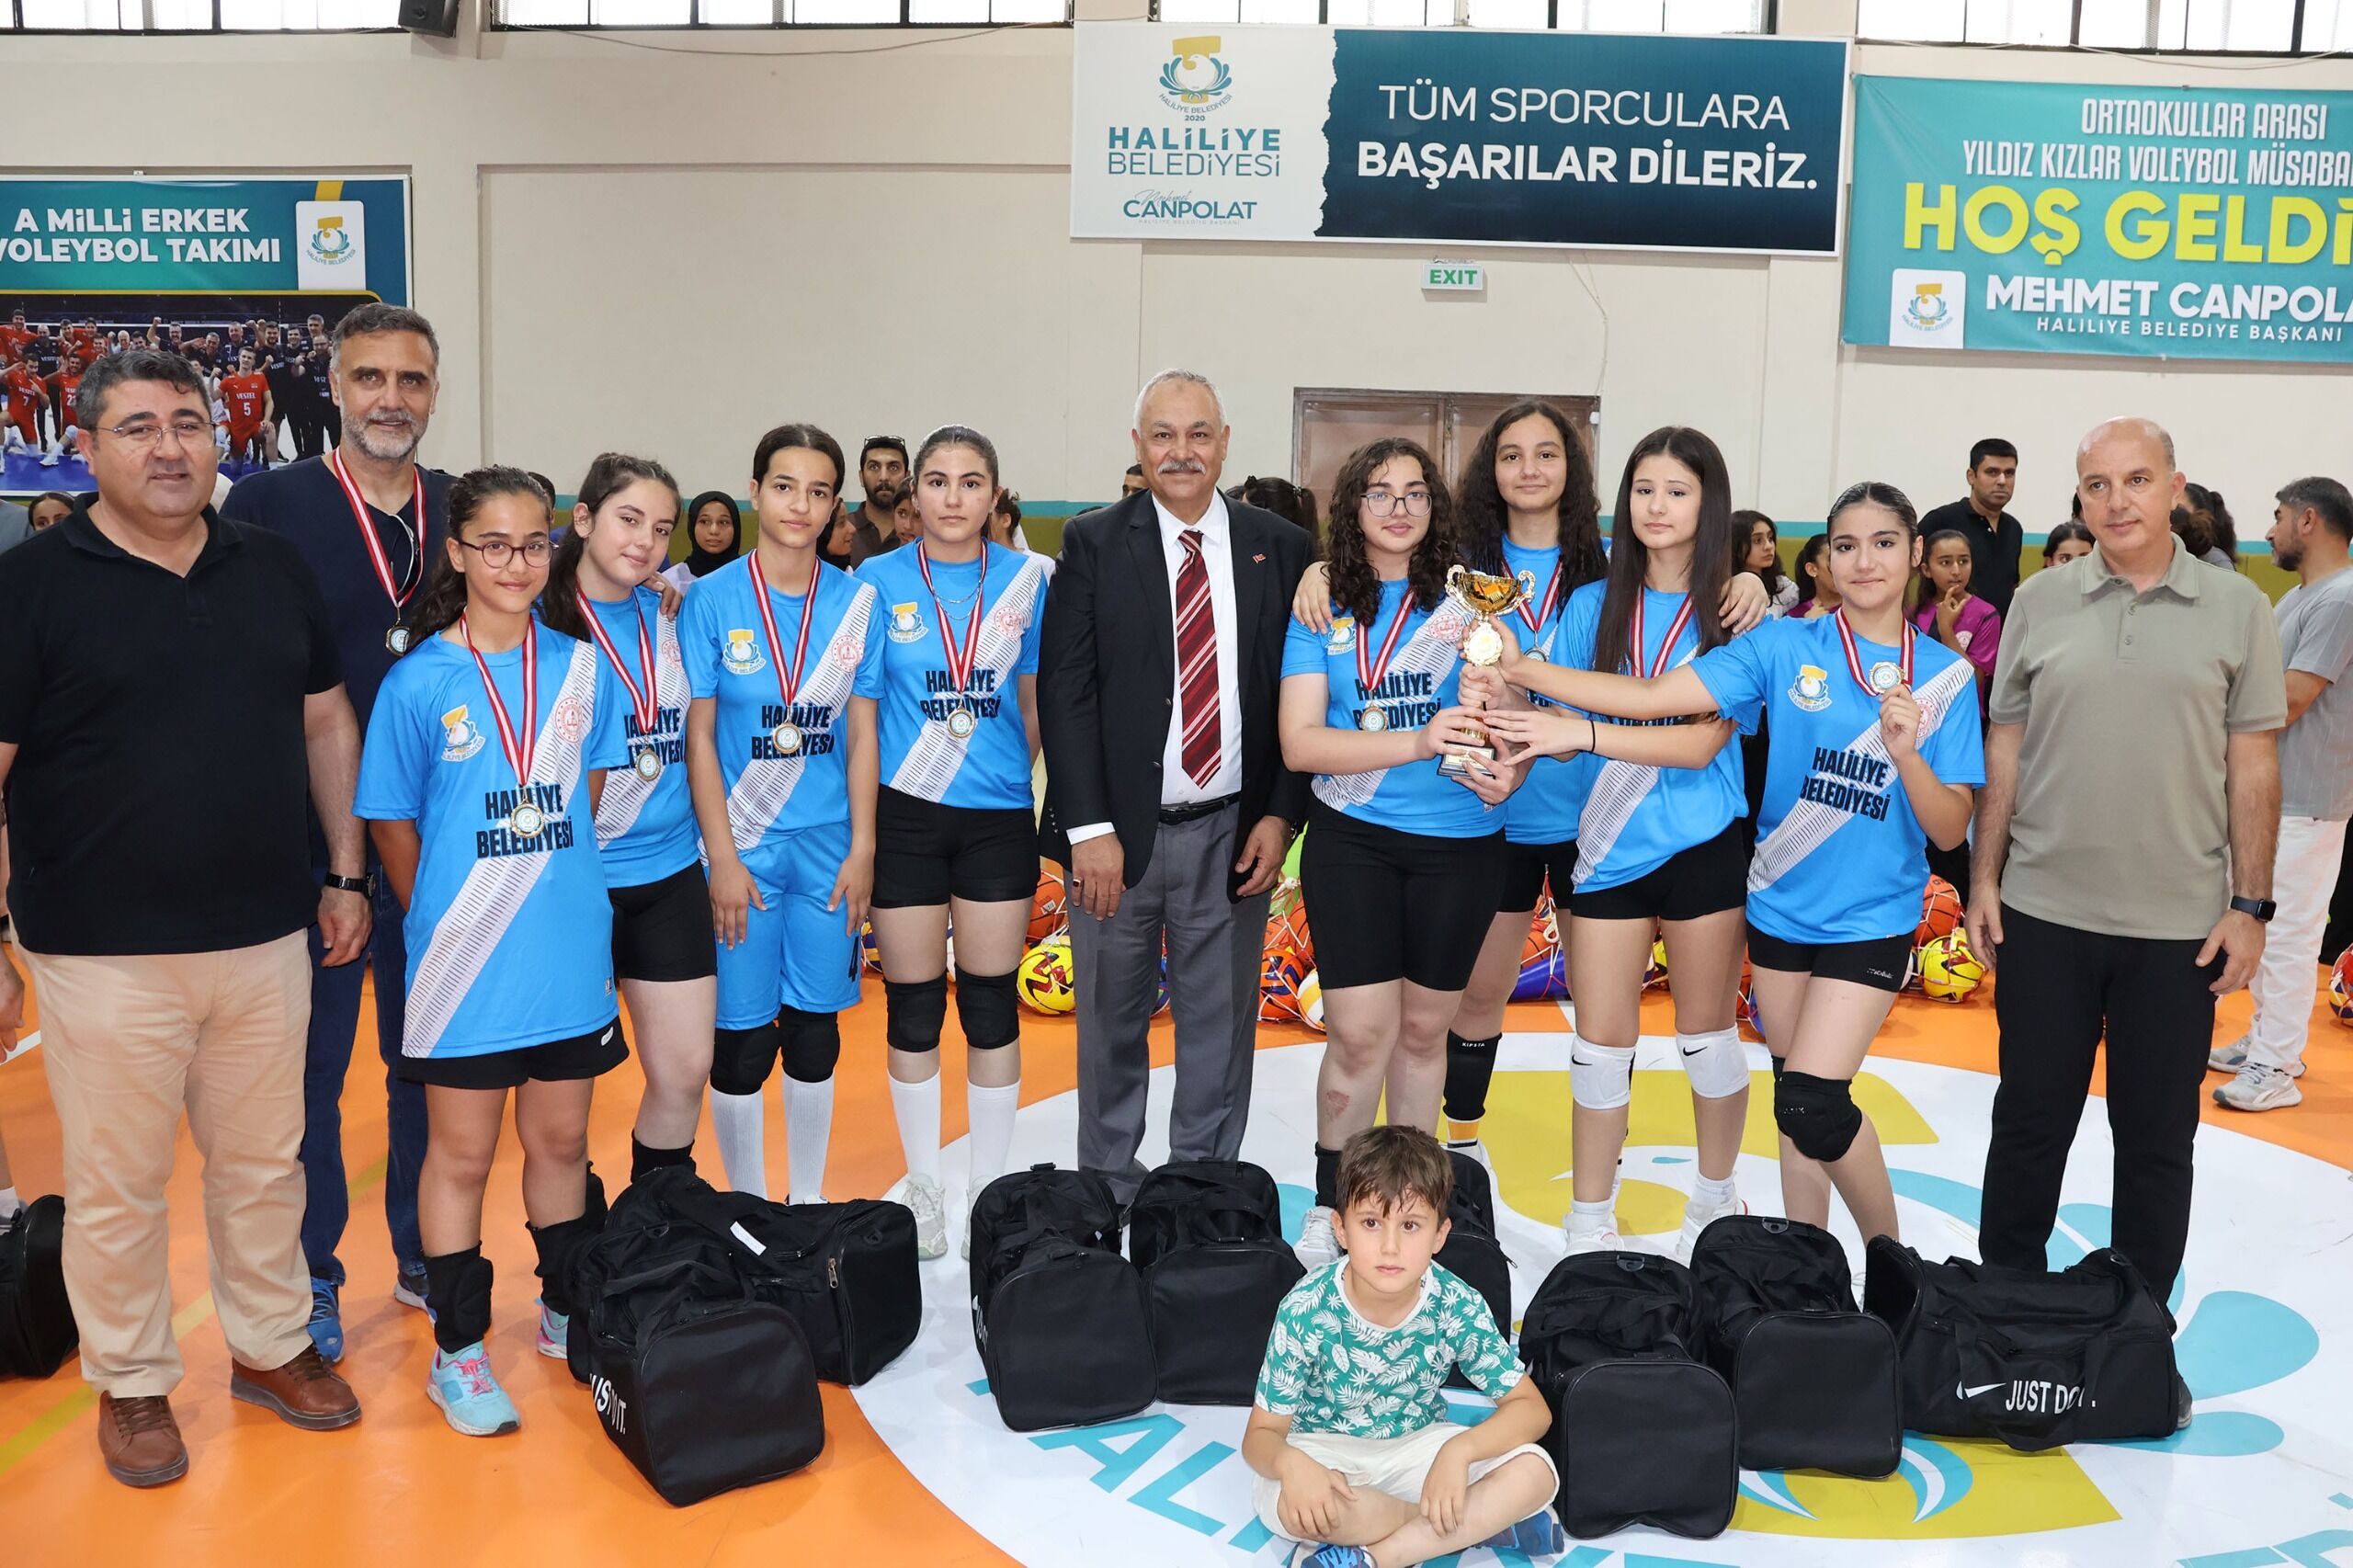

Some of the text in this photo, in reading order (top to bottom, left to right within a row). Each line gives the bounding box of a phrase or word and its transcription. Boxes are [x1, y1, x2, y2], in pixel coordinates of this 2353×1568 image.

[1379, 78, 1790, 131] TÜM SPORCULARA
[2081, 98, 2328, 141] ORTAOKULLAR ARASI
[1358, 138, 1818, 190] BAŞARILAR DİLERİZ.
[1962, 140, 2353, 187] YILDIZ KIZLAR VOLEYBOL MÜSABA
[14, 208, 40, 233] A
[142, 208, 250, 233] ERKEK
[1122, 199, 1258, 220] CANPOLAT
[1904, 182, 2082, 266] HOŞ
[166, 237, 281, 264] TAKIMI
[1429, 269, 1478, 286] EXIT
[1985, 274, 2160, 317] MEHMET
[2249, 324, 2343, 343] BAŞKANI
[243, 402, 251, 415] 5
[926, 666, 995, 693] HALİYE
[1352, 698, 1441, 731] BDİYES
[751, 730, 835, 760] BEYESİ
[1812, 746, 1889, 789] HALİLİYE
[1800, 775, 1892, 823] BELEDİYESİ
[2006, 1380, 2052, 1413] JUST
